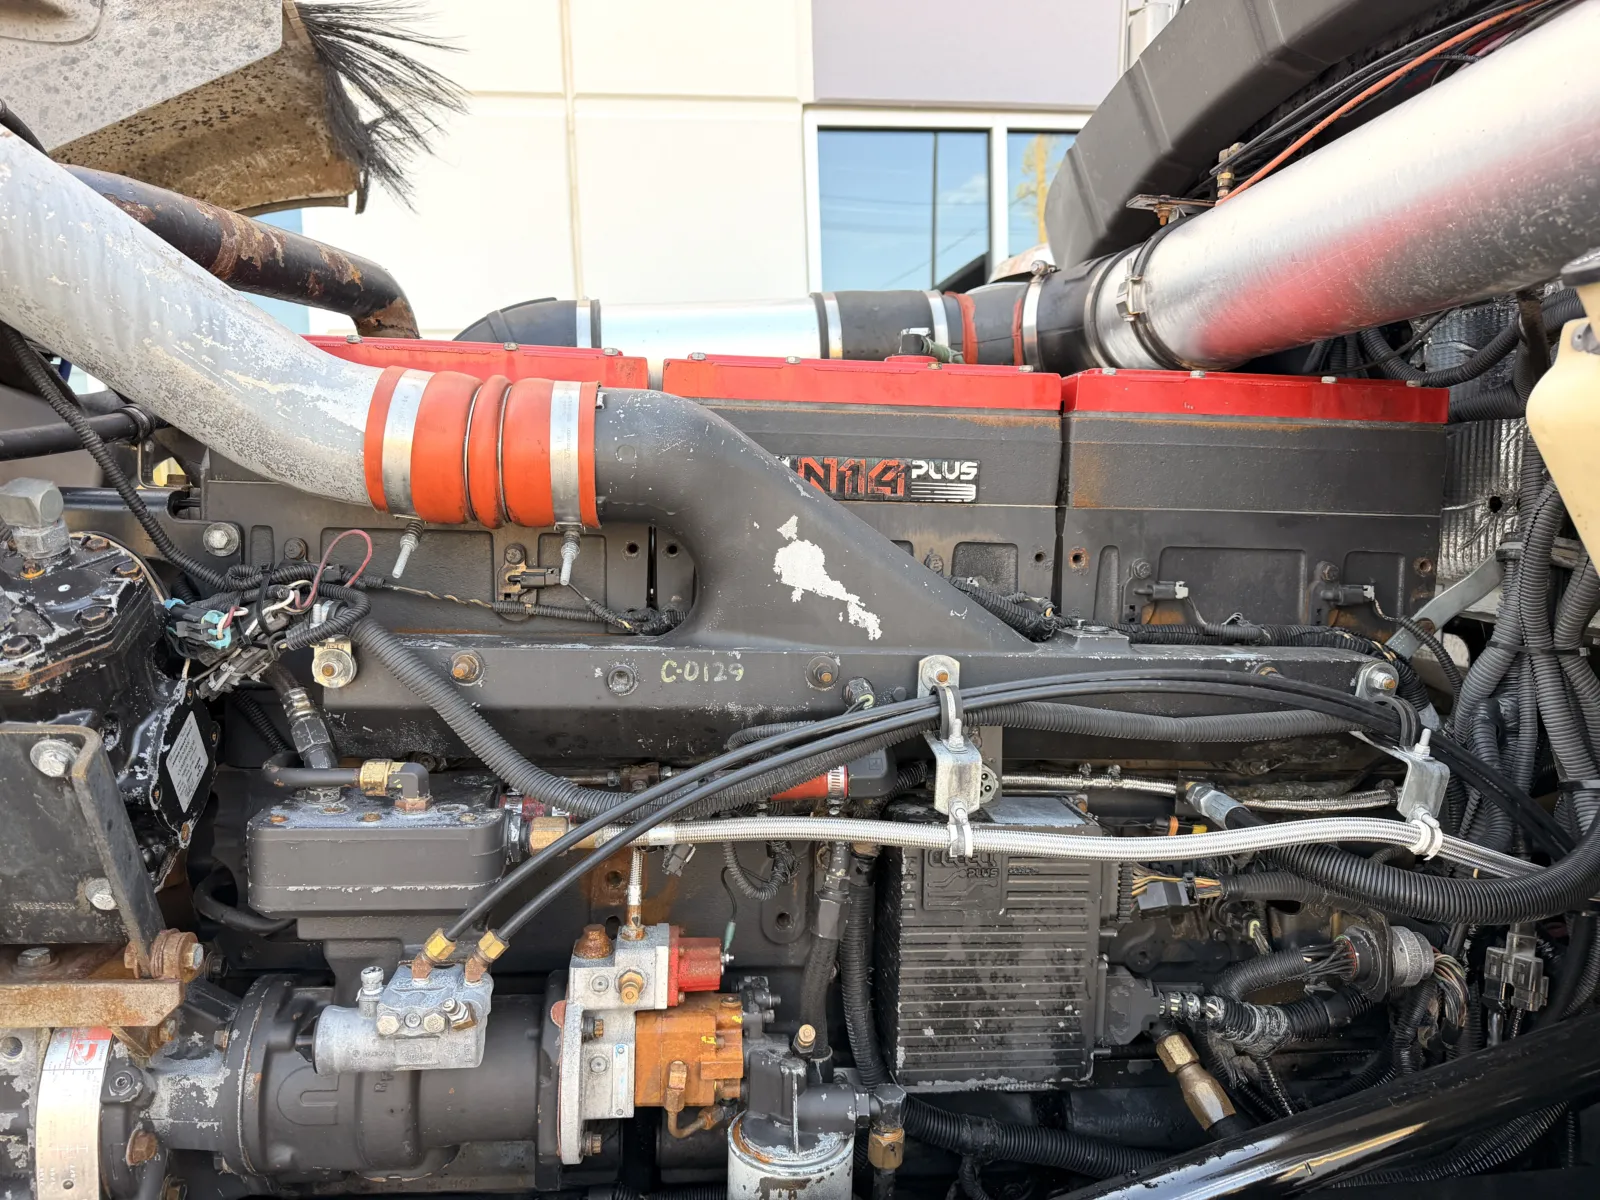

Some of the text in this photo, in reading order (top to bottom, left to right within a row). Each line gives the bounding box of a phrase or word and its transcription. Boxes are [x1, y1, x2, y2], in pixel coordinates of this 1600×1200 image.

[797, 457, 978, 498] N14 PLUS
[967, 868, 999, 878] PLUS
